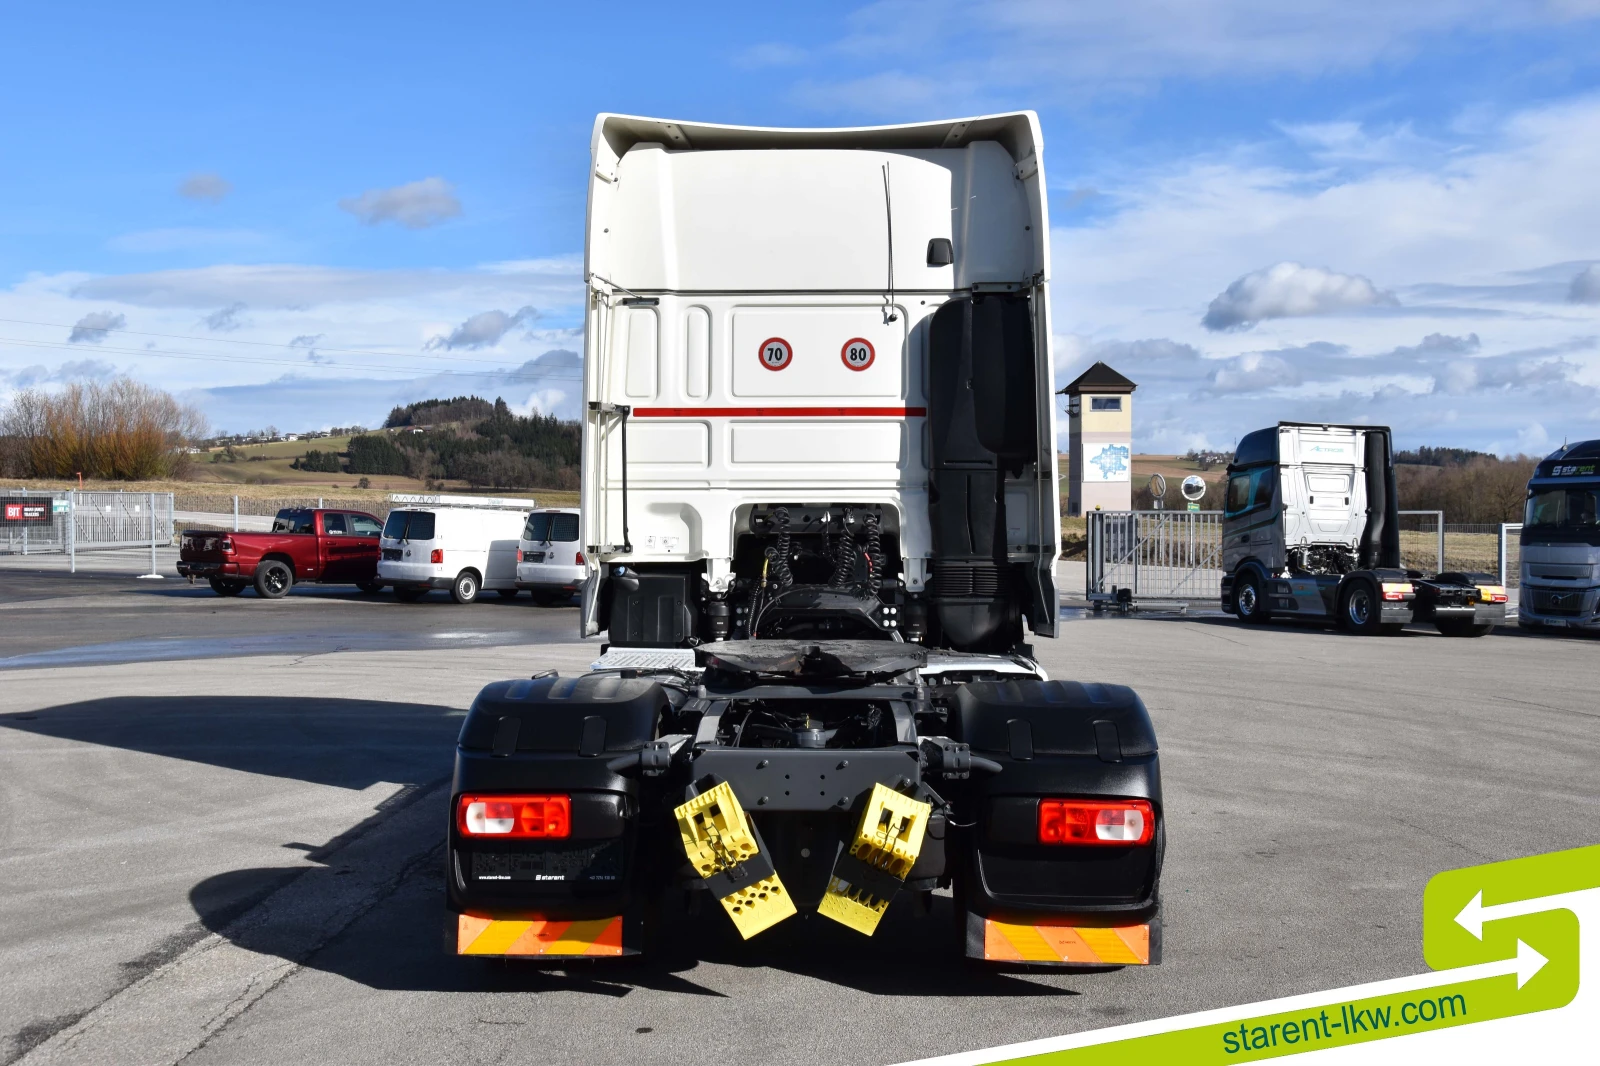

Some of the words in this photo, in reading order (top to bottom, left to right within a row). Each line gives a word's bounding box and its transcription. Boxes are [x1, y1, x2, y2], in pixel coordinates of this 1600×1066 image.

[767, 347, 783, 361] 70
[850, 347, 867, 361] 80
[7, 507, 20, 517] BJT
